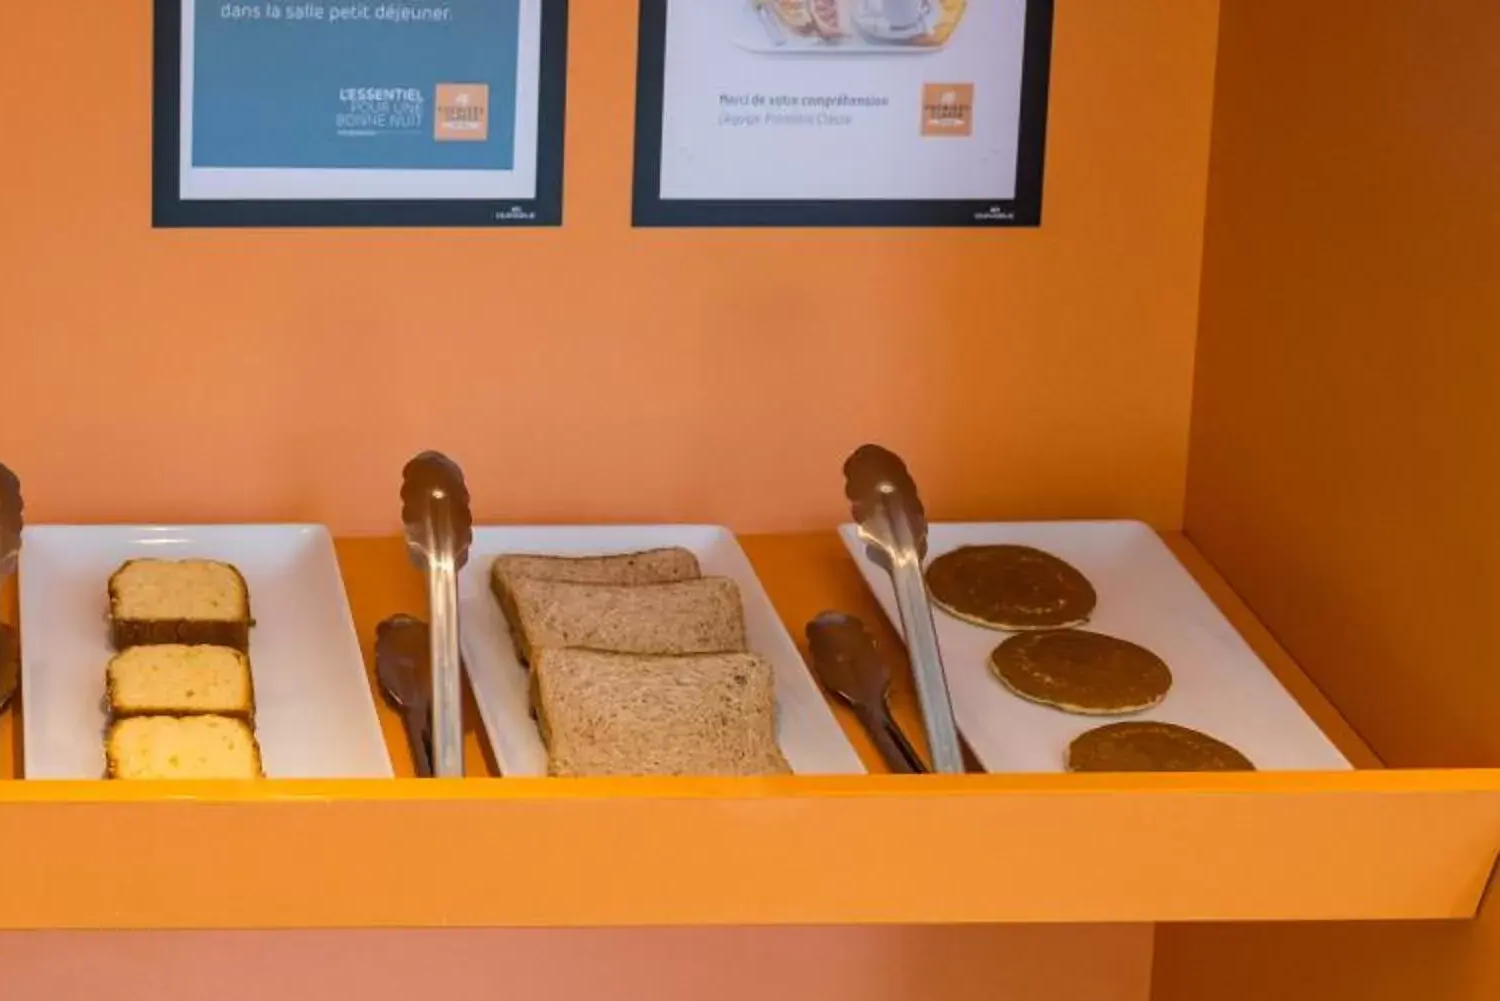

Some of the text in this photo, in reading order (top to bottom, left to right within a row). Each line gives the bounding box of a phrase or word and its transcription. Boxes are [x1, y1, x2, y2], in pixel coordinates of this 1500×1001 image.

[221, 2, 261, 19] dans
[266, 2, 280, 19] la
[285, 2, 324, 19] salle
[329, 3, 369, 23] petit
[339, 87, 423, 101] L'ESSENTIEL
[719, 94, 750, 106] Merci
[752, 94, 766, 106] de
